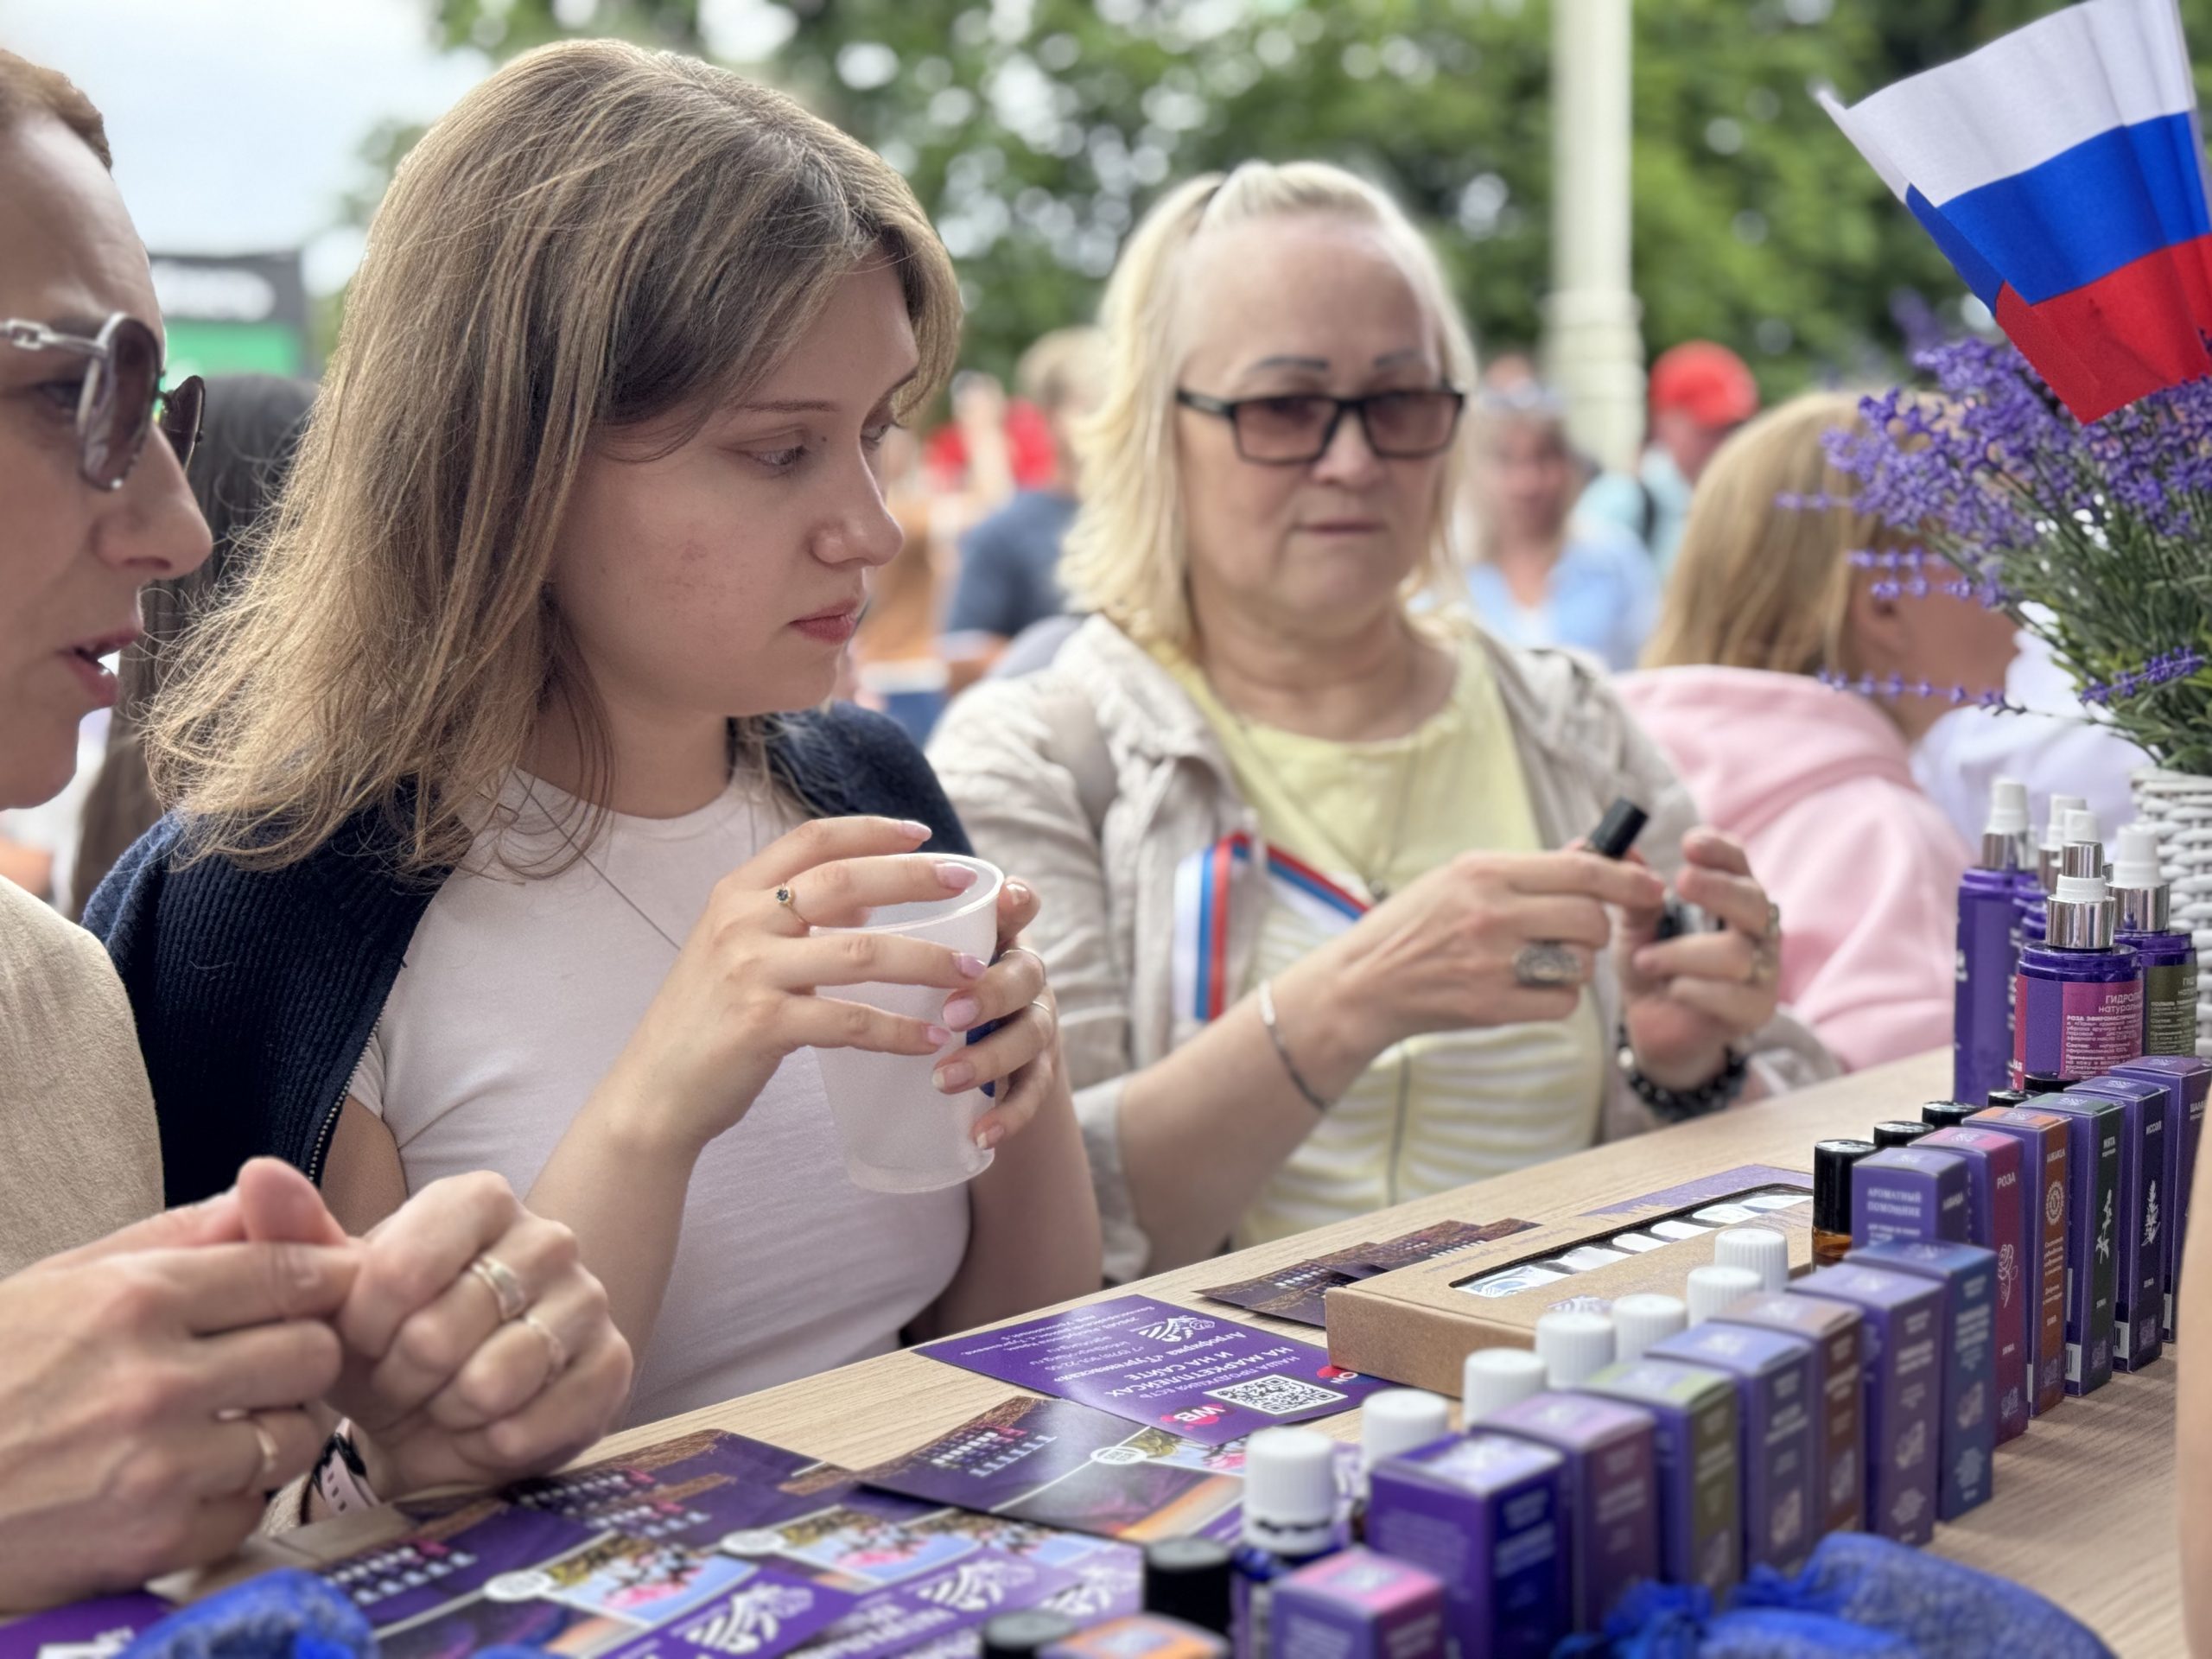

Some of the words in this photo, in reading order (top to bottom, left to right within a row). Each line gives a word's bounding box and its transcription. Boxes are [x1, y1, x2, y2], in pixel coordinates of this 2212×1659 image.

[1997, 1172, 2016, 1190] РОЗА
[1261, 1346, 1294, 1357] НА
[1184, 1356, 1217, 1366] НА
[1255, 1356, 1300, 1370] НАША
[1104, 1354, 1264, 1397] МАРКЕТПЛЕЙСАХ
[1124, 1363, 1186, 1381] САЙТЕ
[1140, 1388, 1176, 1398] ЕСТЬ
[1173, 1406, 1226, 1422] WB
